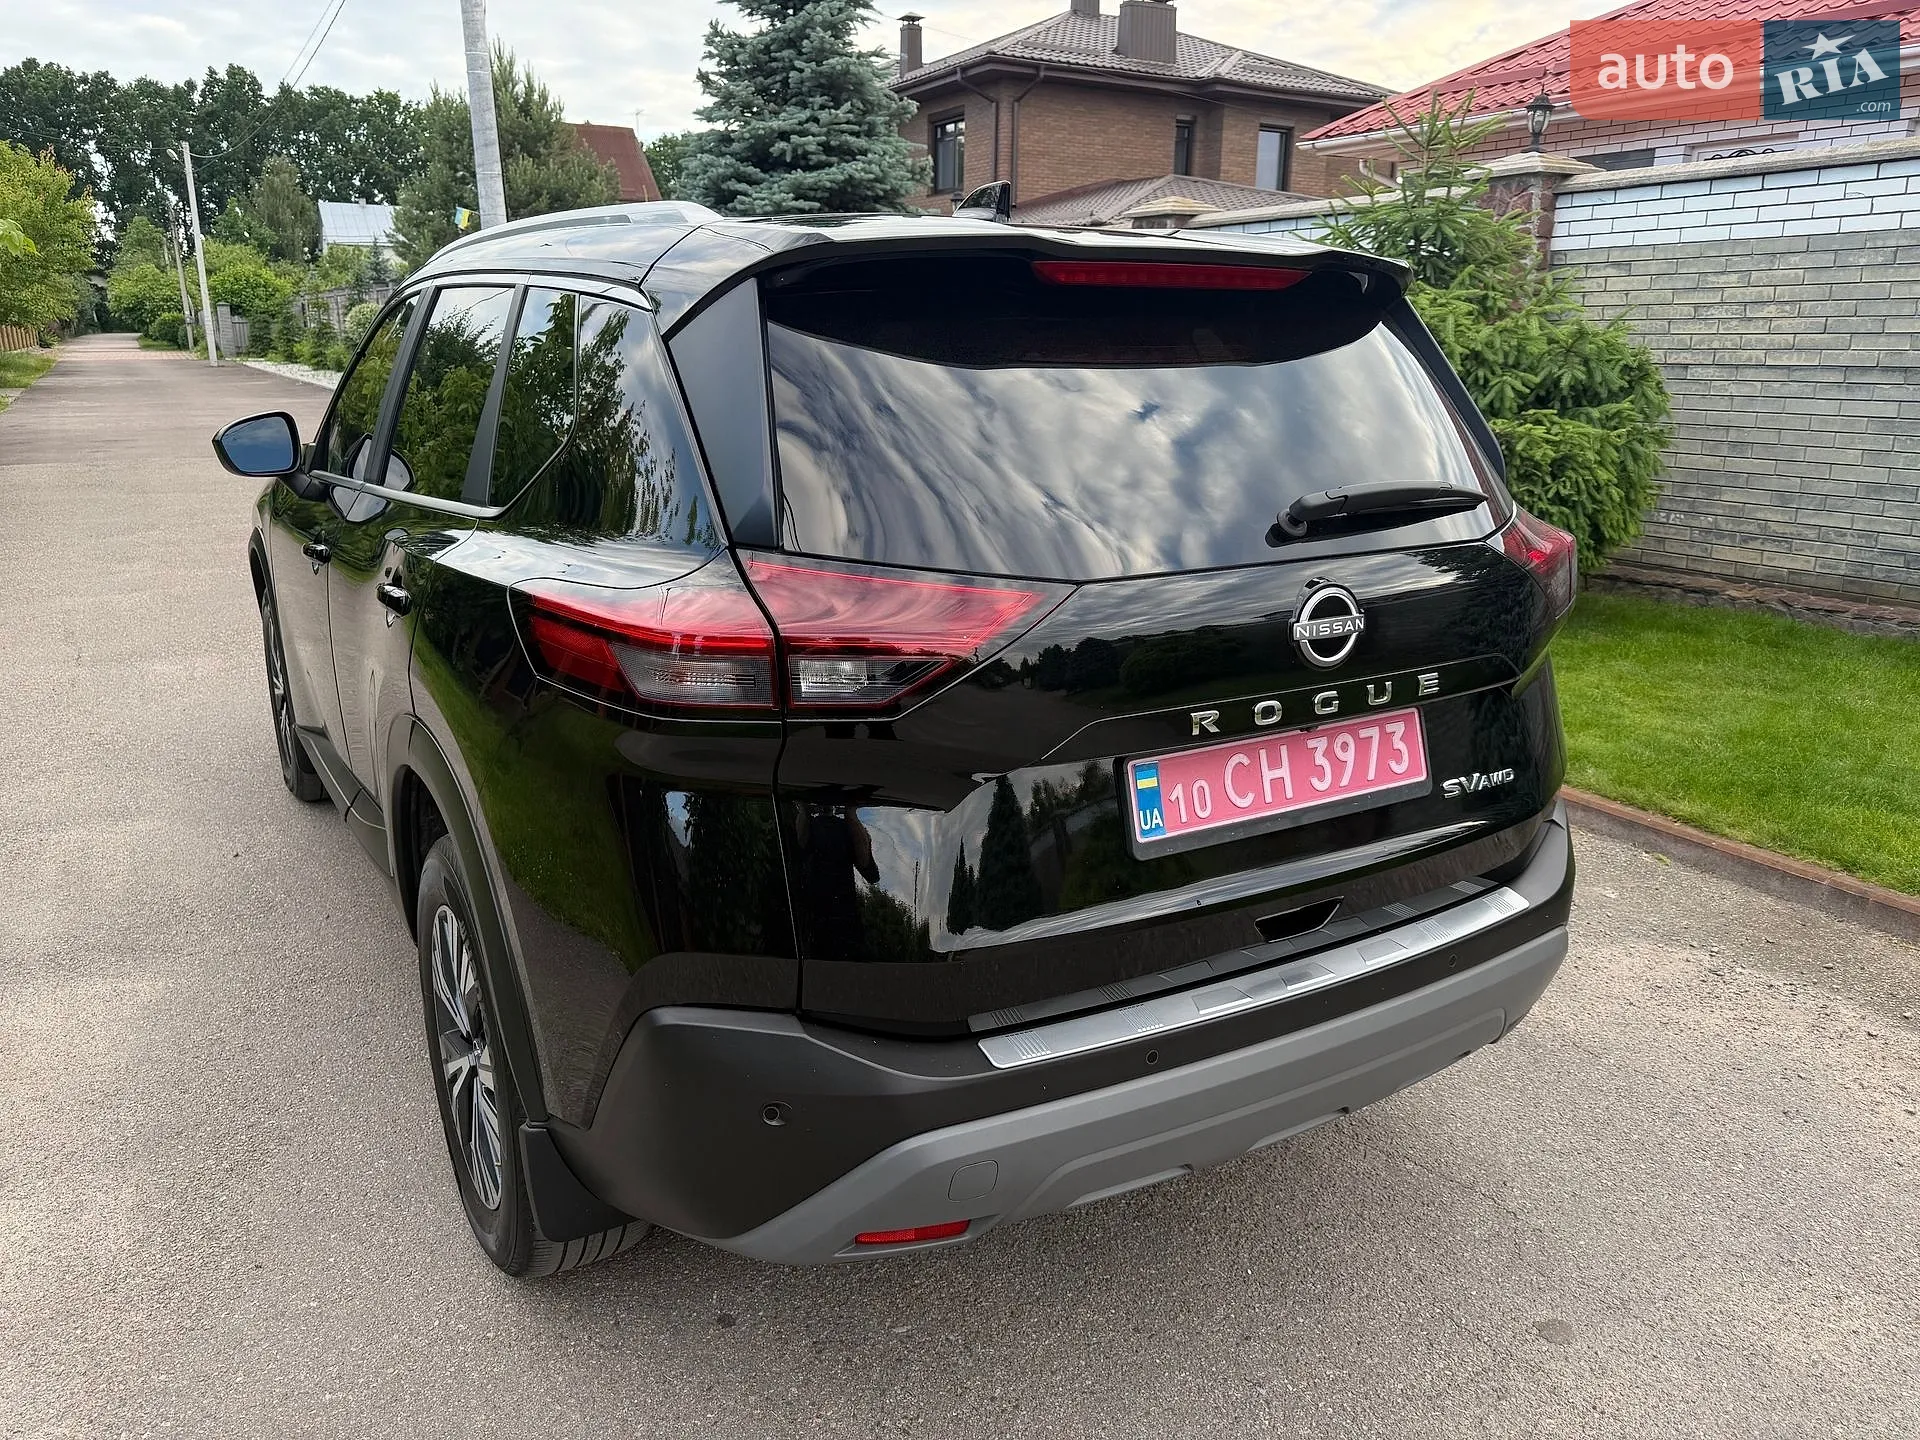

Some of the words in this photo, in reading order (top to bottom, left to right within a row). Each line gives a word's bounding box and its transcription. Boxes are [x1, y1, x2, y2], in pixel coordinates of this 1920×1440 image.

[1296, 617, 1364, 638] NISSAN
[1191, 672, 1440, 736] ROGUE
[1168, 778, 1213, 824] 10
[1224, 745, 1294, 809] CH
[1306, 721, 1410, 792] 3973
[1139, 807, 1164, 831] UA
